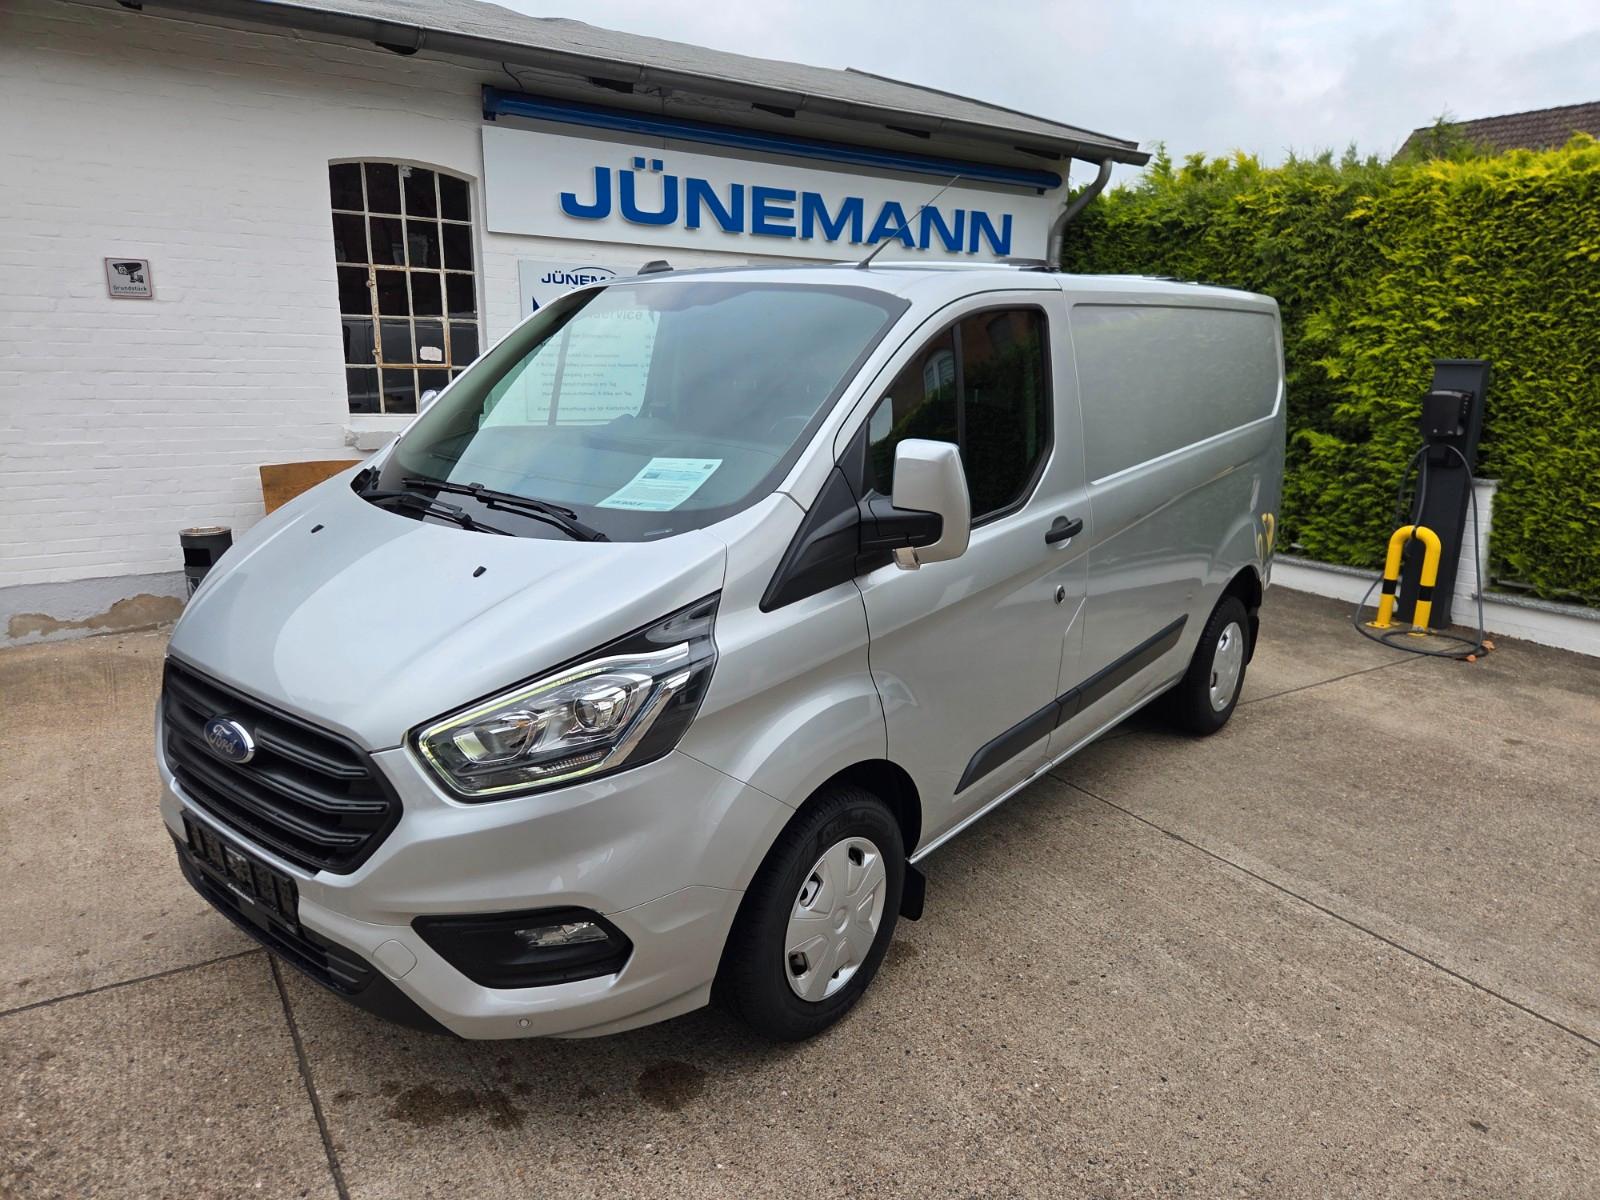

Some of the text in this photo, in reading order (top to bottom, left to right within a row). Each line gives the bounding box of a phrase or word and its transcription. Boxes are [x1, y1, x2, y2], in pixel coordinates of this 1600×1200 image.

[560, 157, 1013, 256] JÜNEMANN
[541, 270, 607, 286] JÜNEM
[208, 724, 239, 754] Ford
